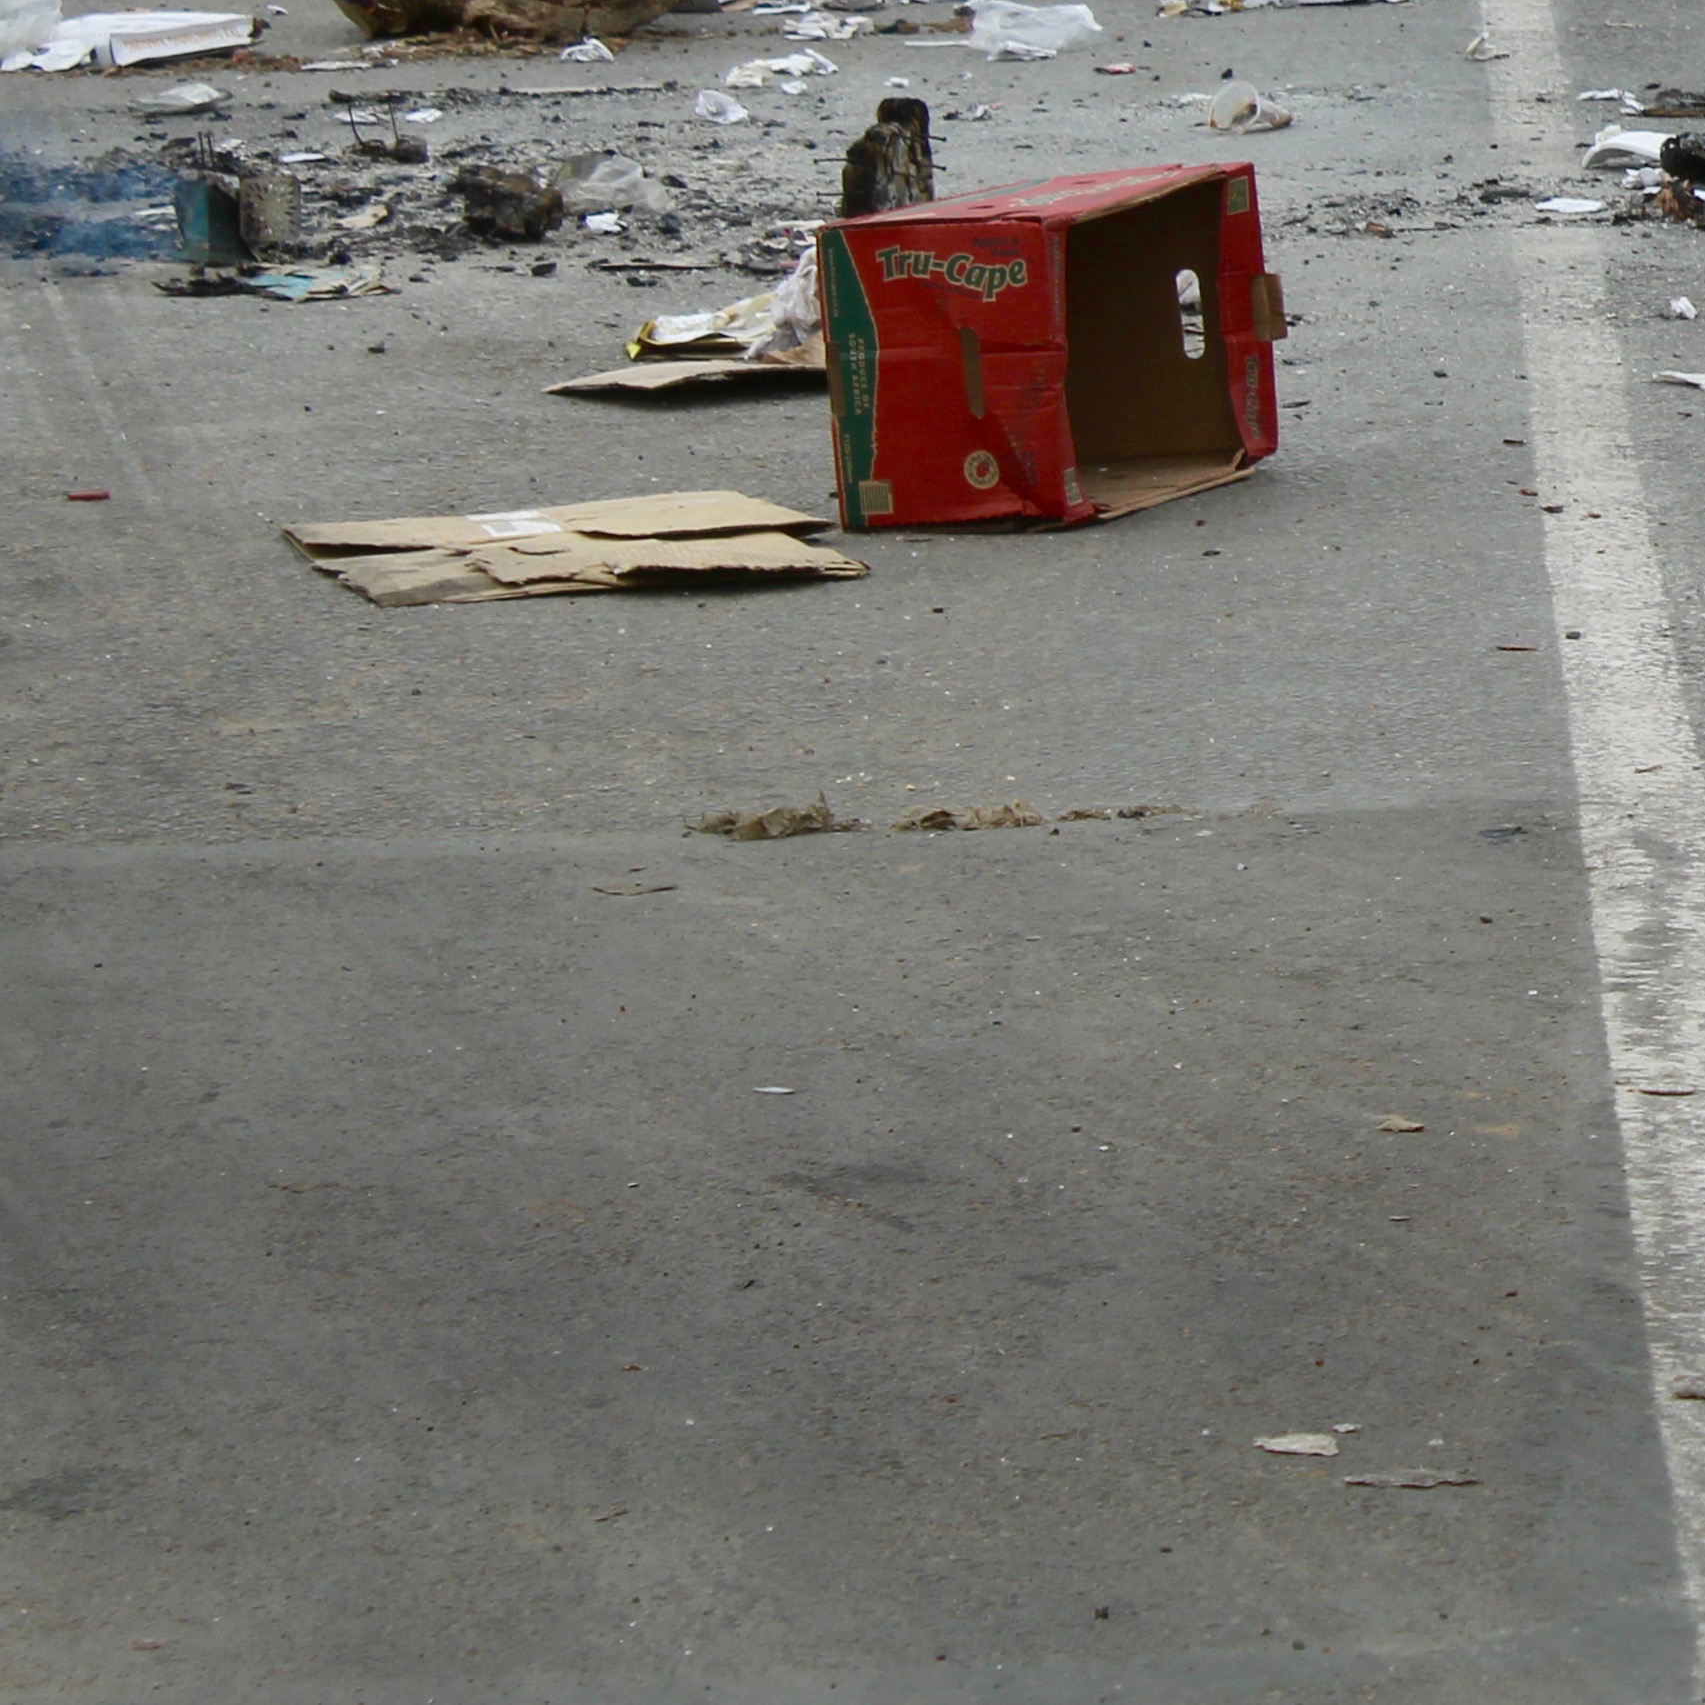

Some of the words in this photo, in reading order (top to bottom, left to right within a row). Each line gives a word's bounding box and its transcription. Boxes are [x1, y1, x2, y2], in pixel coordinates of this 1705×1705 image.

[876, 245, 1028, 302] Tru-Cape
[848, 332, 857, 370] SOUTH
[857, 338, 868, 389] PRODUCE
[852, 374, 862, 415] AFRICA
[862, 394, 870, 408] OF
